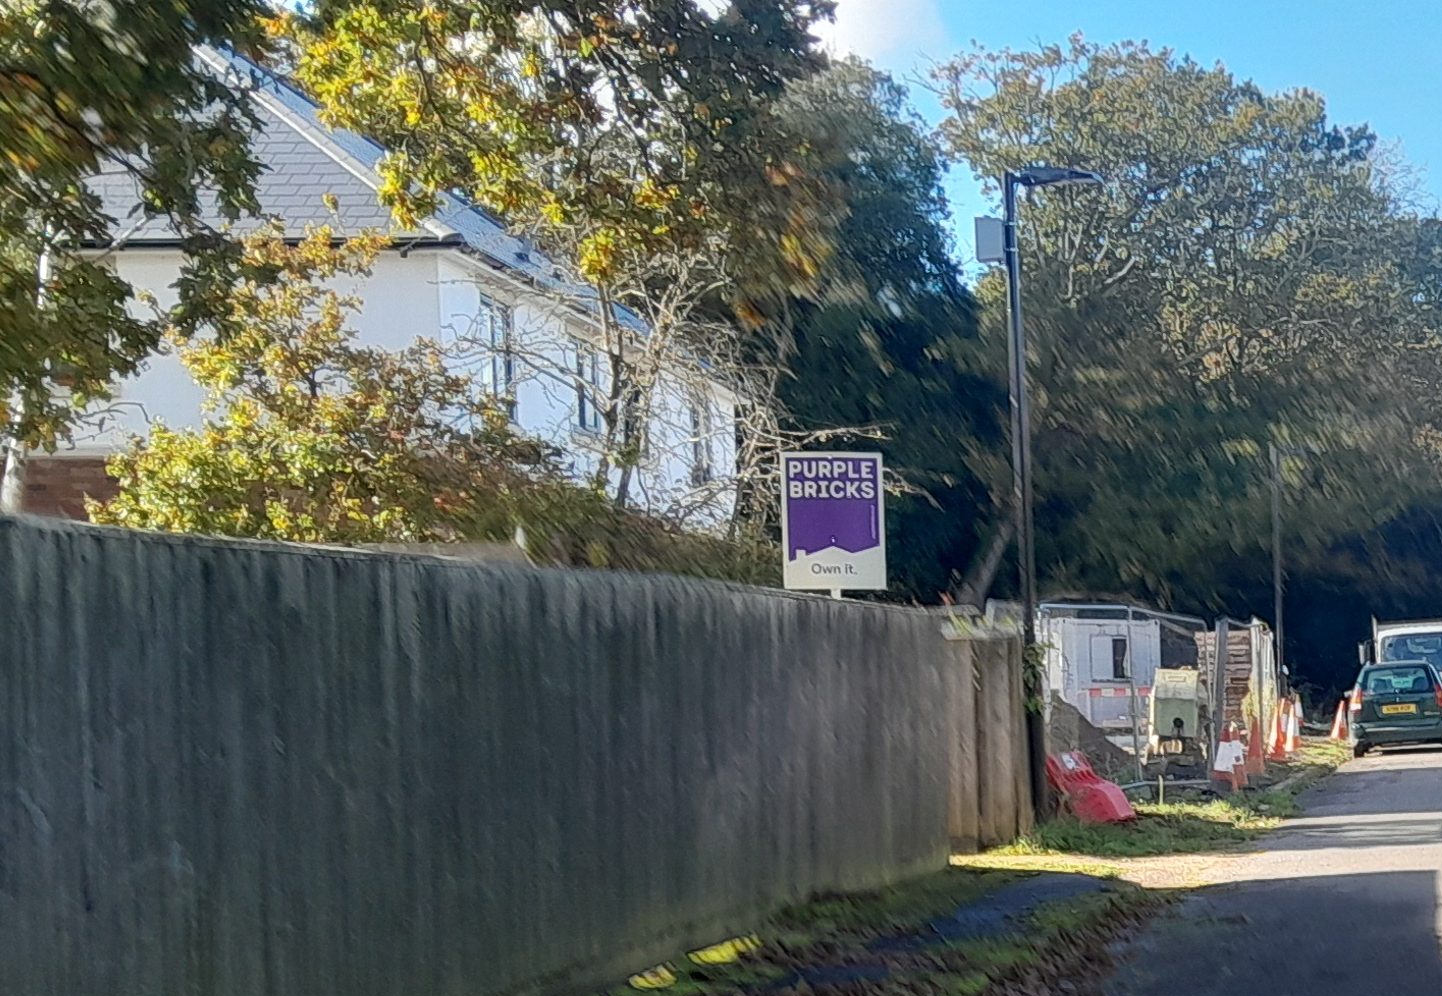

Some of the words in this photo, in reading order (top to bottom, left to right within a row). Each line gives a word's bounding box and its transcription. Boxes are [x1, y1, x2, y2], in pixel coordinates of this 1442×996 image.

[788, 461, 874, 479] PURPLE
[789, 481, 875, 499] BRICKS
[811, 563, 841, 575] Own
[845, 563, 858, 575] it.
